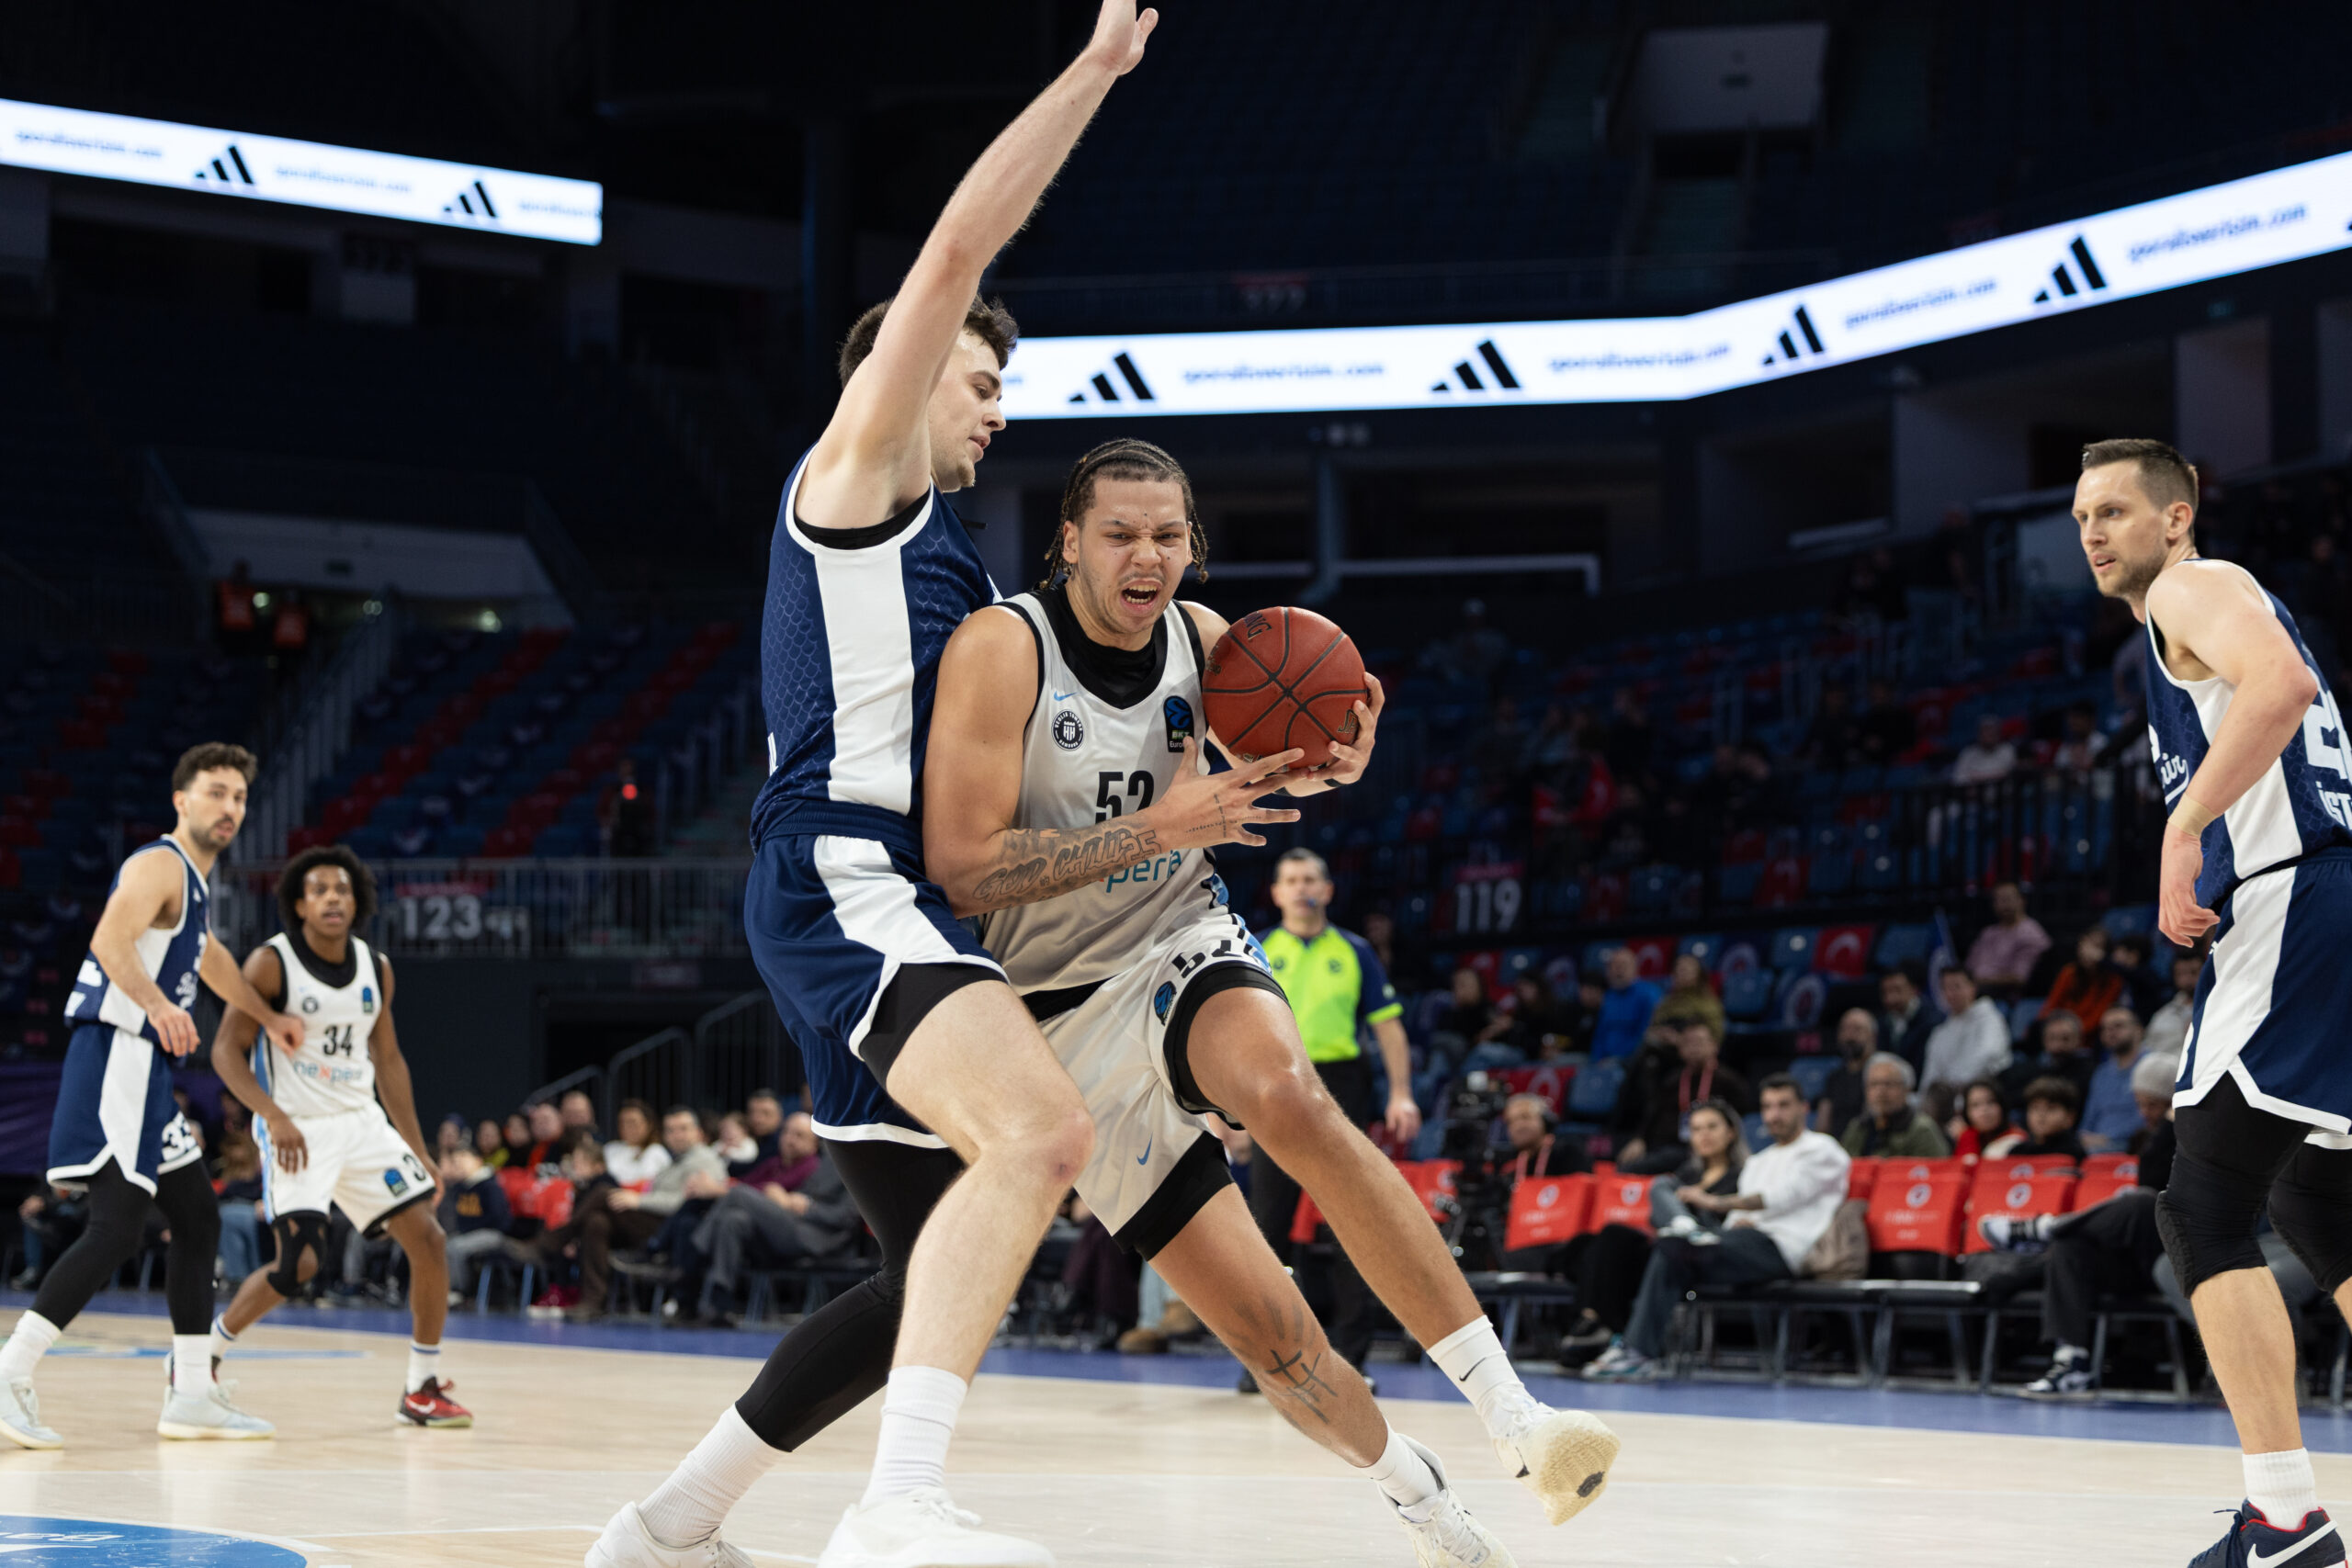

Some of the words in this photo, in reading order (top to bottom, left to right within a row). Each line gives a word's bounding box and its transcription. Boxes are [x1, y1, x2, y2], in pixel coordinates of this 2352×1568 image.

[1095, 770, 1155, 826] 52
[2315, 781, 2352, 830] İST
[400, 894, 481, 940] 123
[1455, 879, 1521, 933] 119
[323, 1023, 353, 1056] 34
